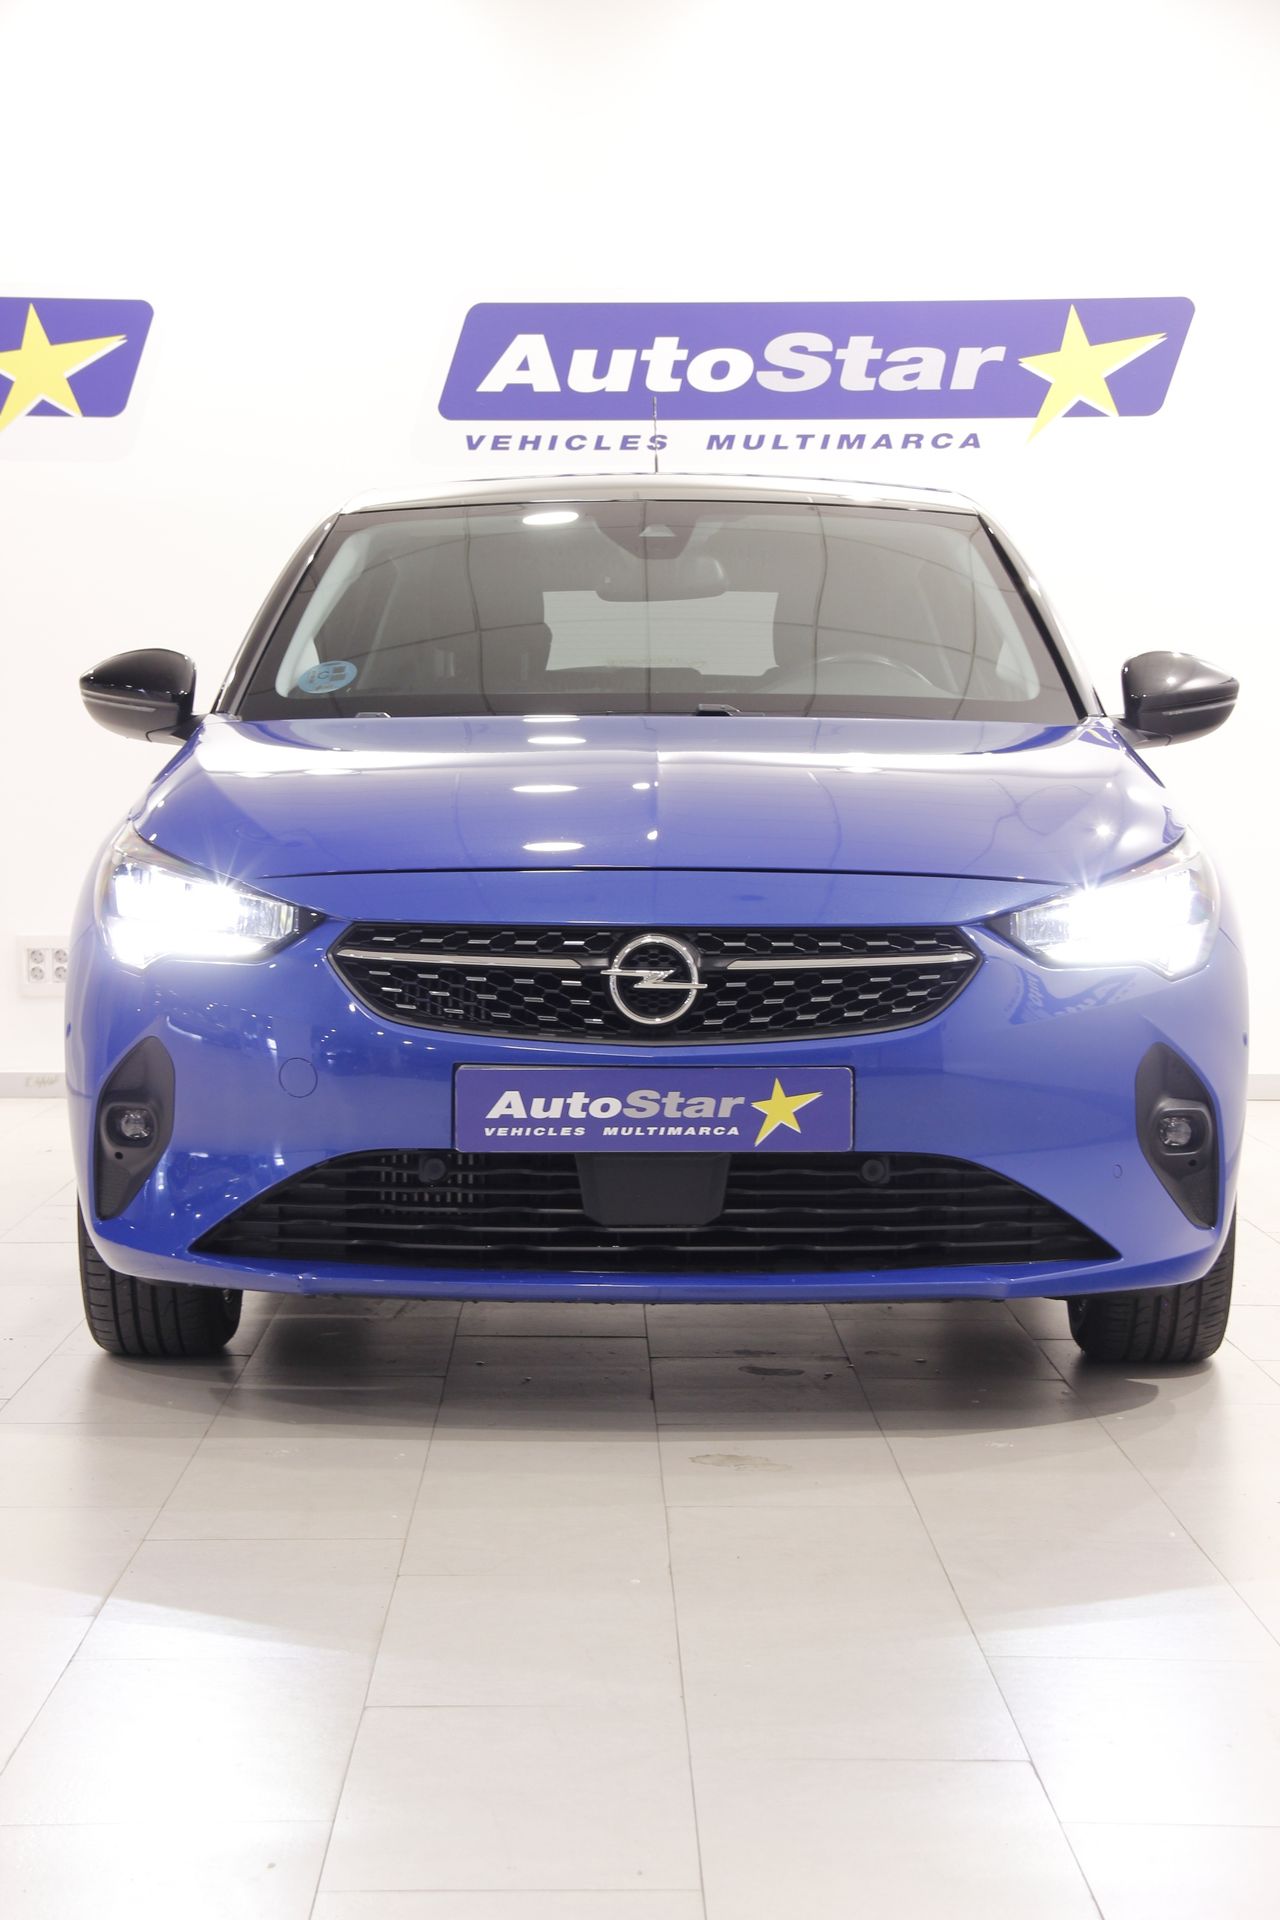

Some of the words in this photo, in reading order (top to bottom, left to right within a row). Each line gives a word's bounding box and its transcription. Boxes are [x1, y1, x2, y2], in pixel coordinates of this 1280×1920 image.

[476, 332, 1006, 393] AutoStar
[466, 434, 668, 451] VEHICLES
[707, 433, 982, 450] MULTIMARCA
[485, 1090, 745, 1118] AutoStar
[484, 1127, 587, 1137] VEHICLES
[602, 1127, 740, 1136] MULTIMARCA
